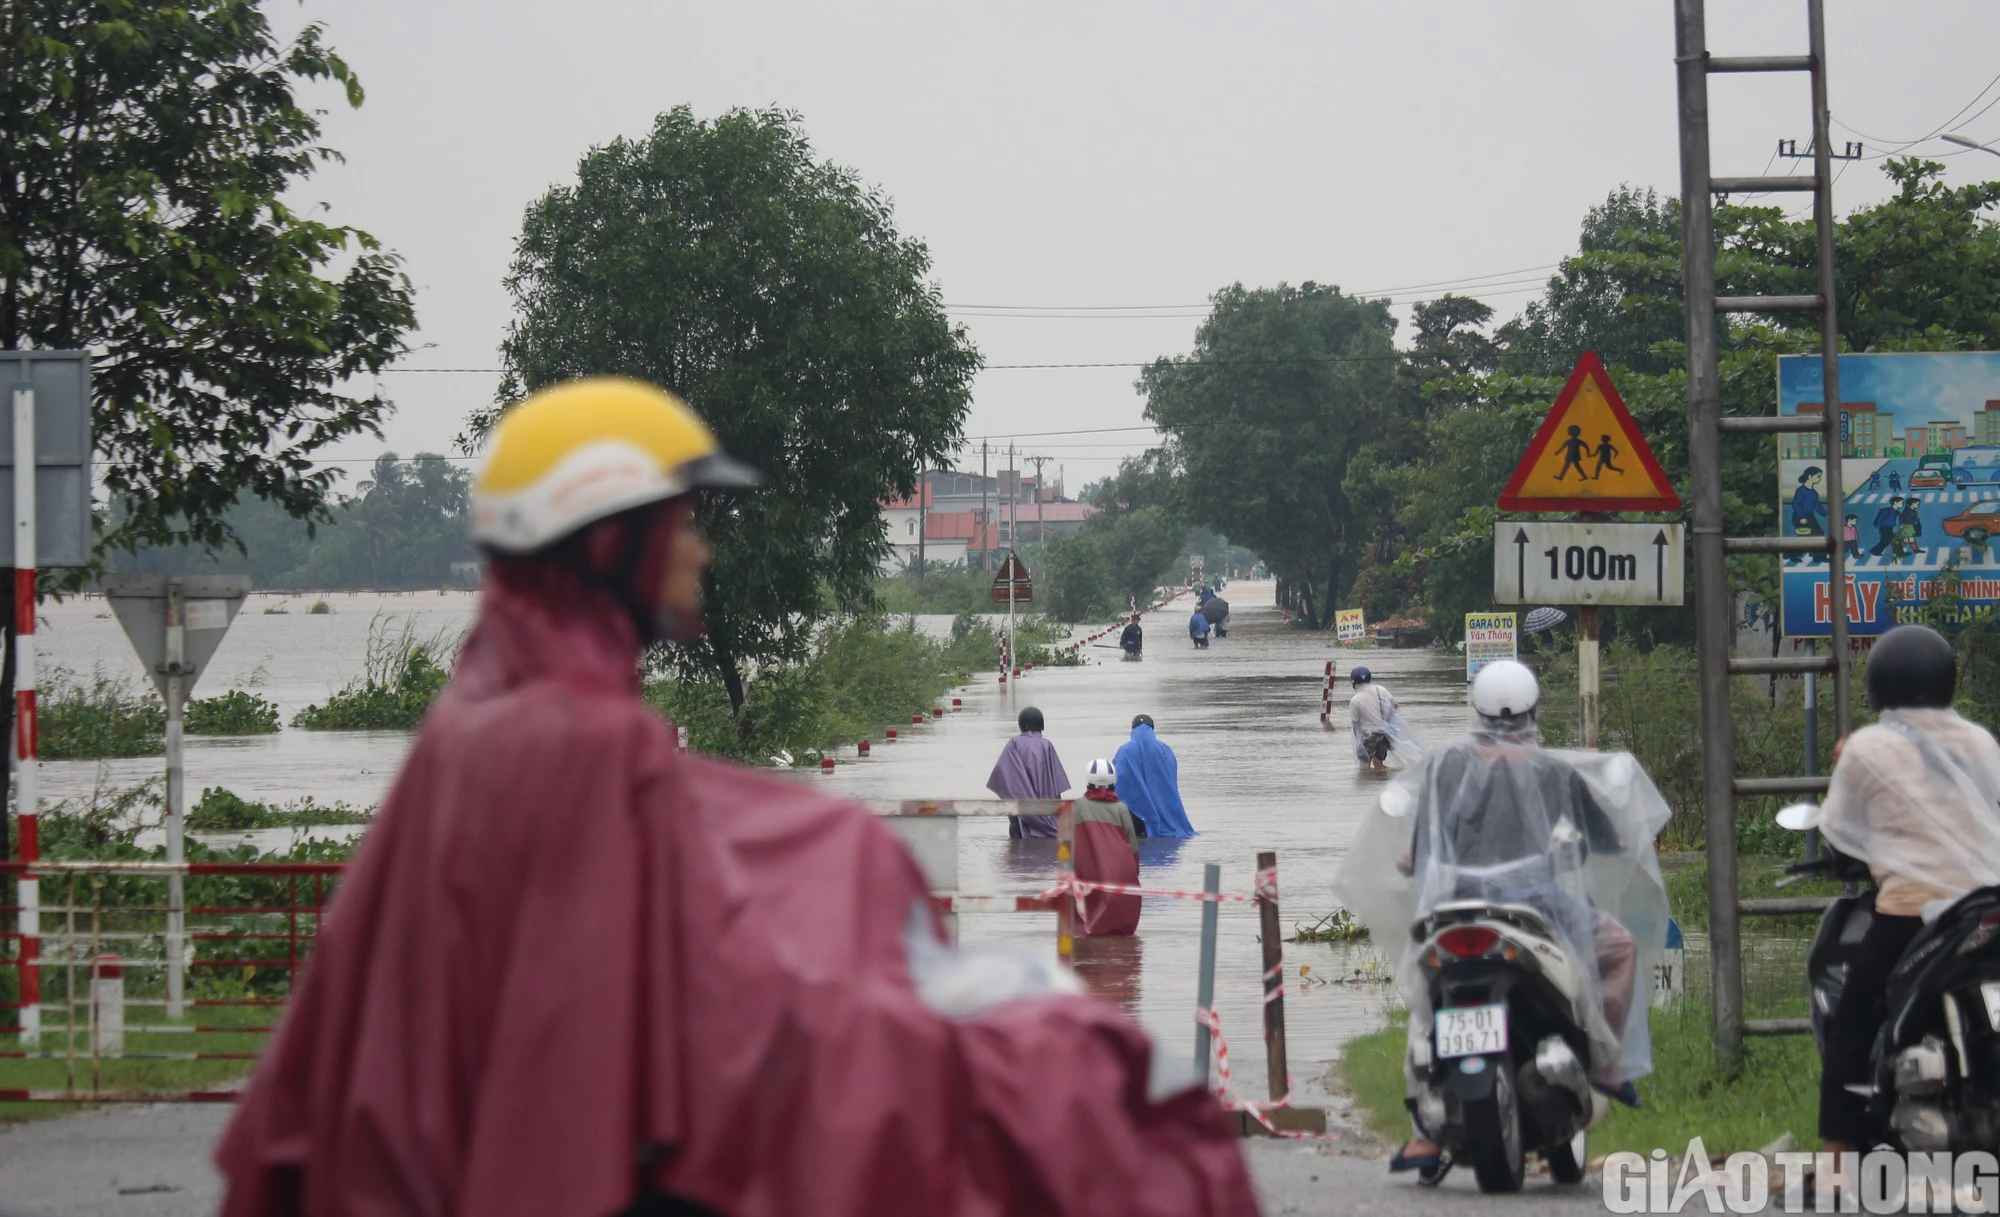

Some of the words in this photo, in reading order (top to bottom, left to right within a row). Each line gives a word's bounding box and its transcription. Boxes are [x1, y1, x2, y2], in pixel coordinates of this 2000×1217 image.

[1543, 545, 1637, 581] 100m
[1814, 573, 1881, 623] HÃY
[1469, 618, 1493, 629] GARA
